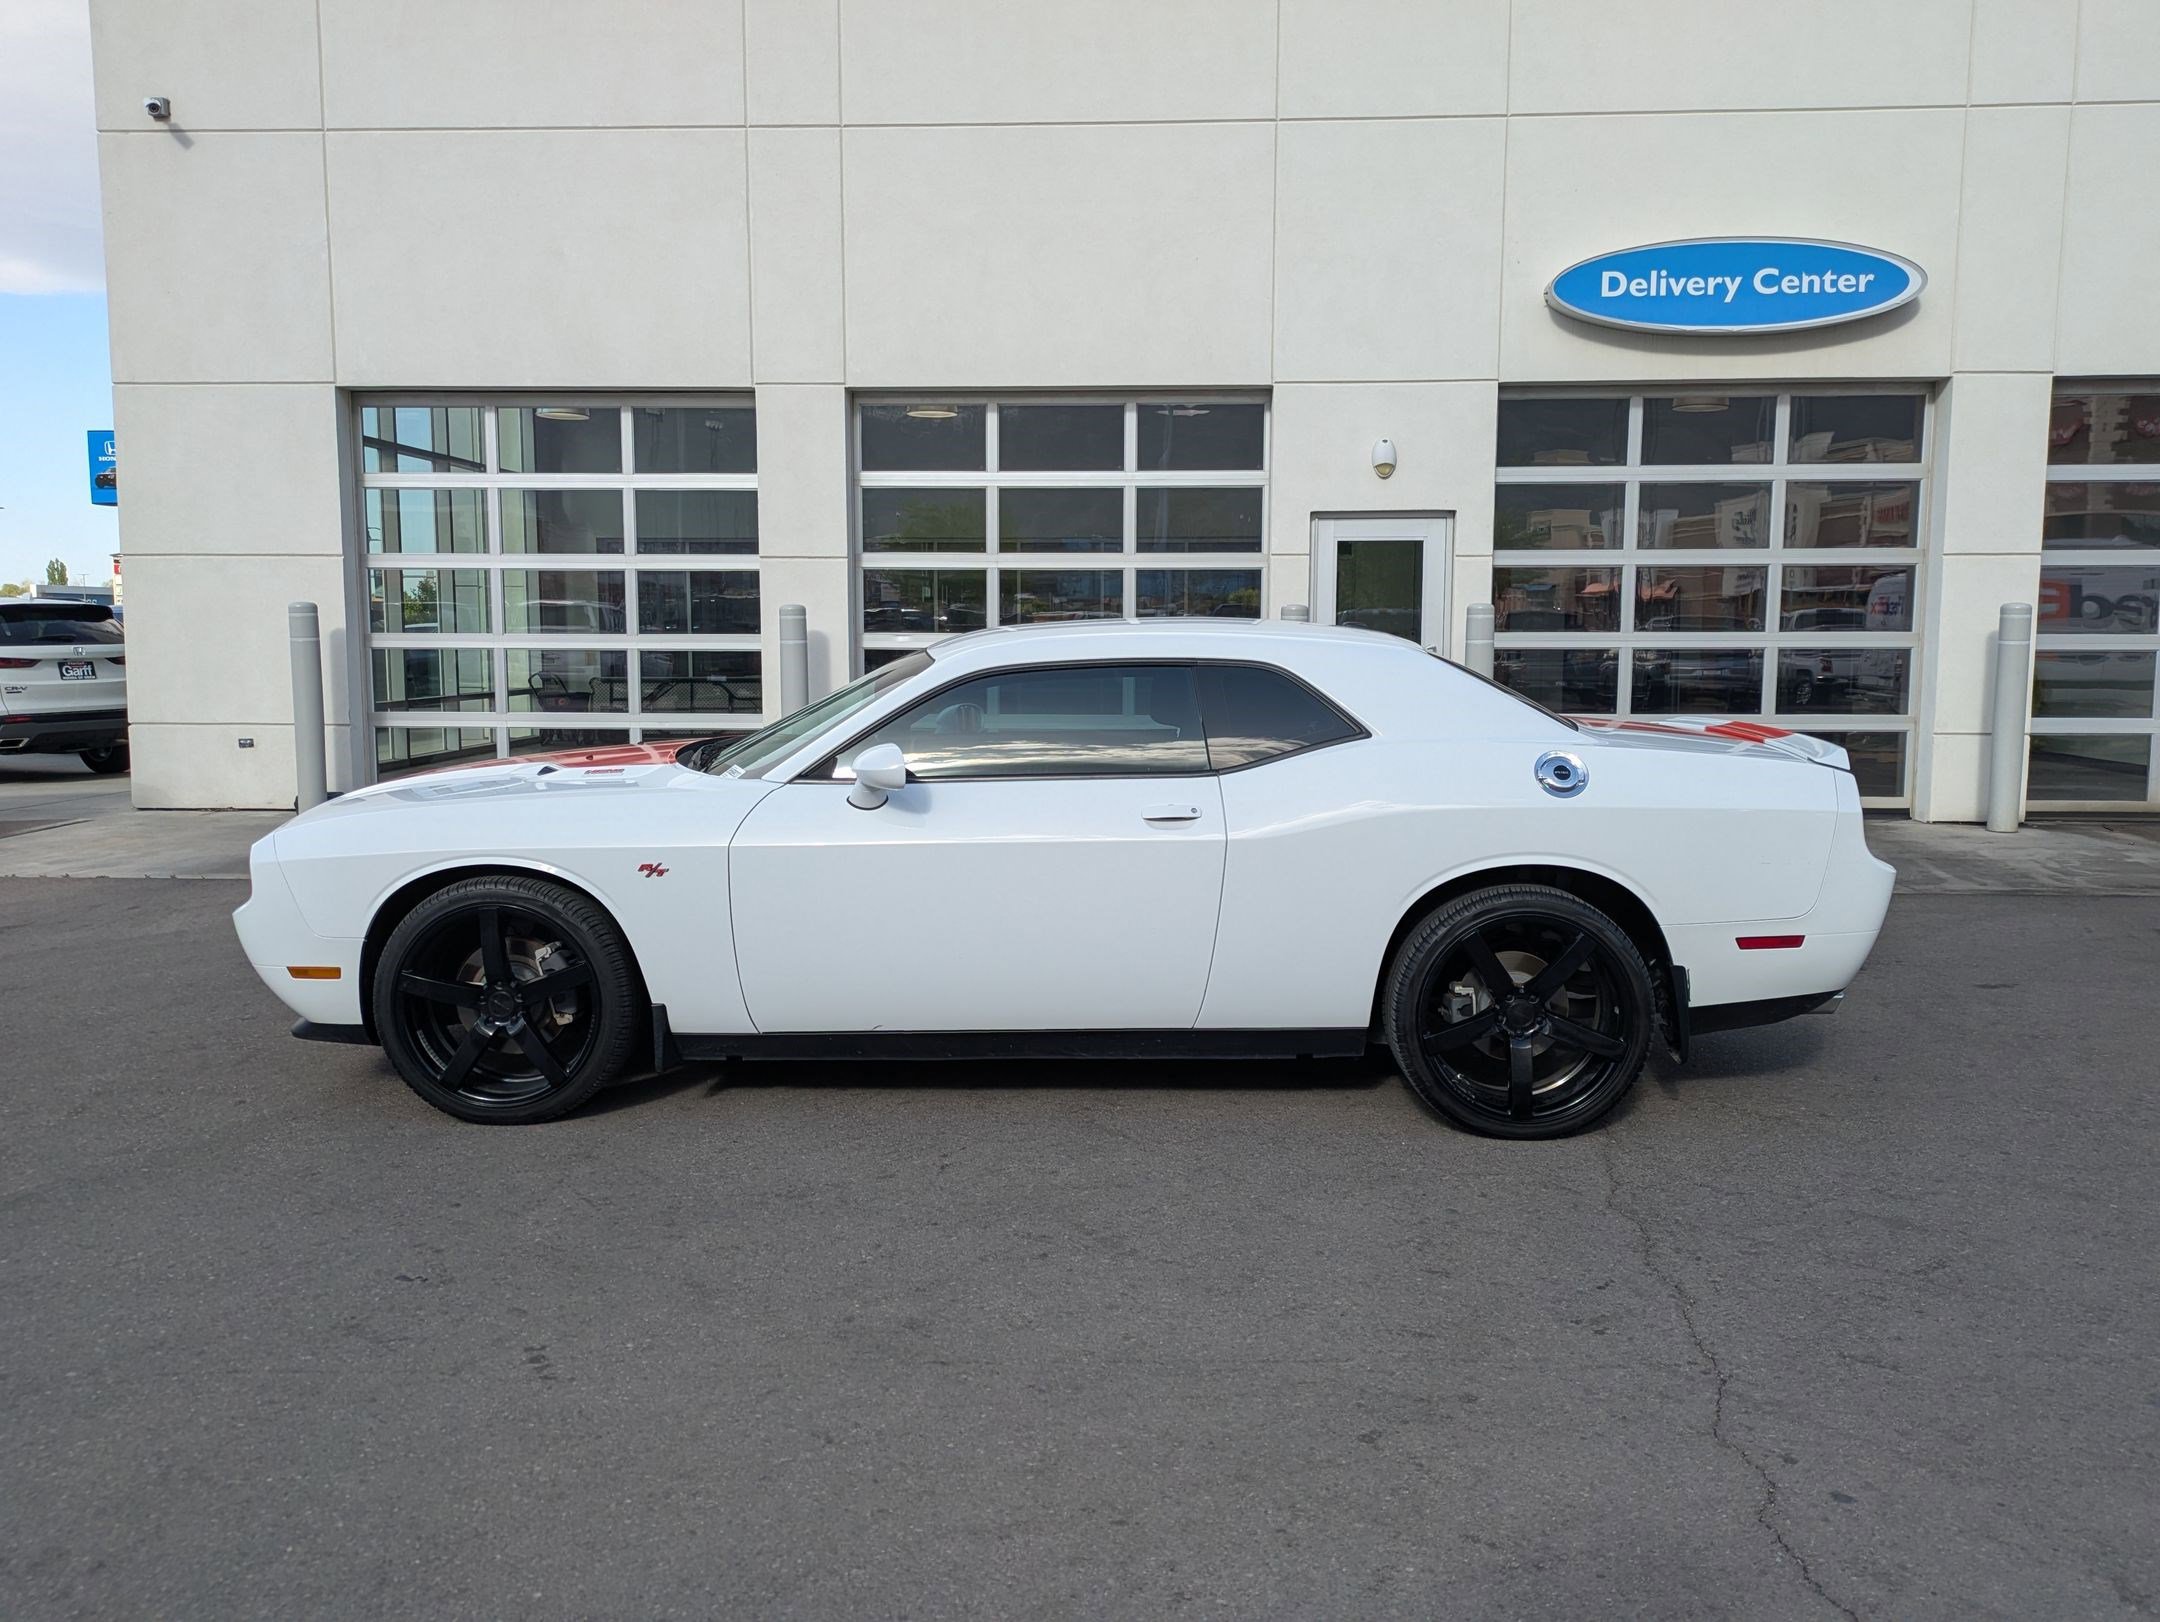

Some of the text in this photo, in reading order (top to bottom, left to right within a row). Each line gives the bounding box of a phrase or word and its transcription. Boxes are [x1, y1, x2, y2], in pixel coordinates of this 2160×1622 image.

[1601, 267, 1875, 303] Delivery Center
[62, 664, 92, 677] Garff
[637, 862, 670, 878] R/T
